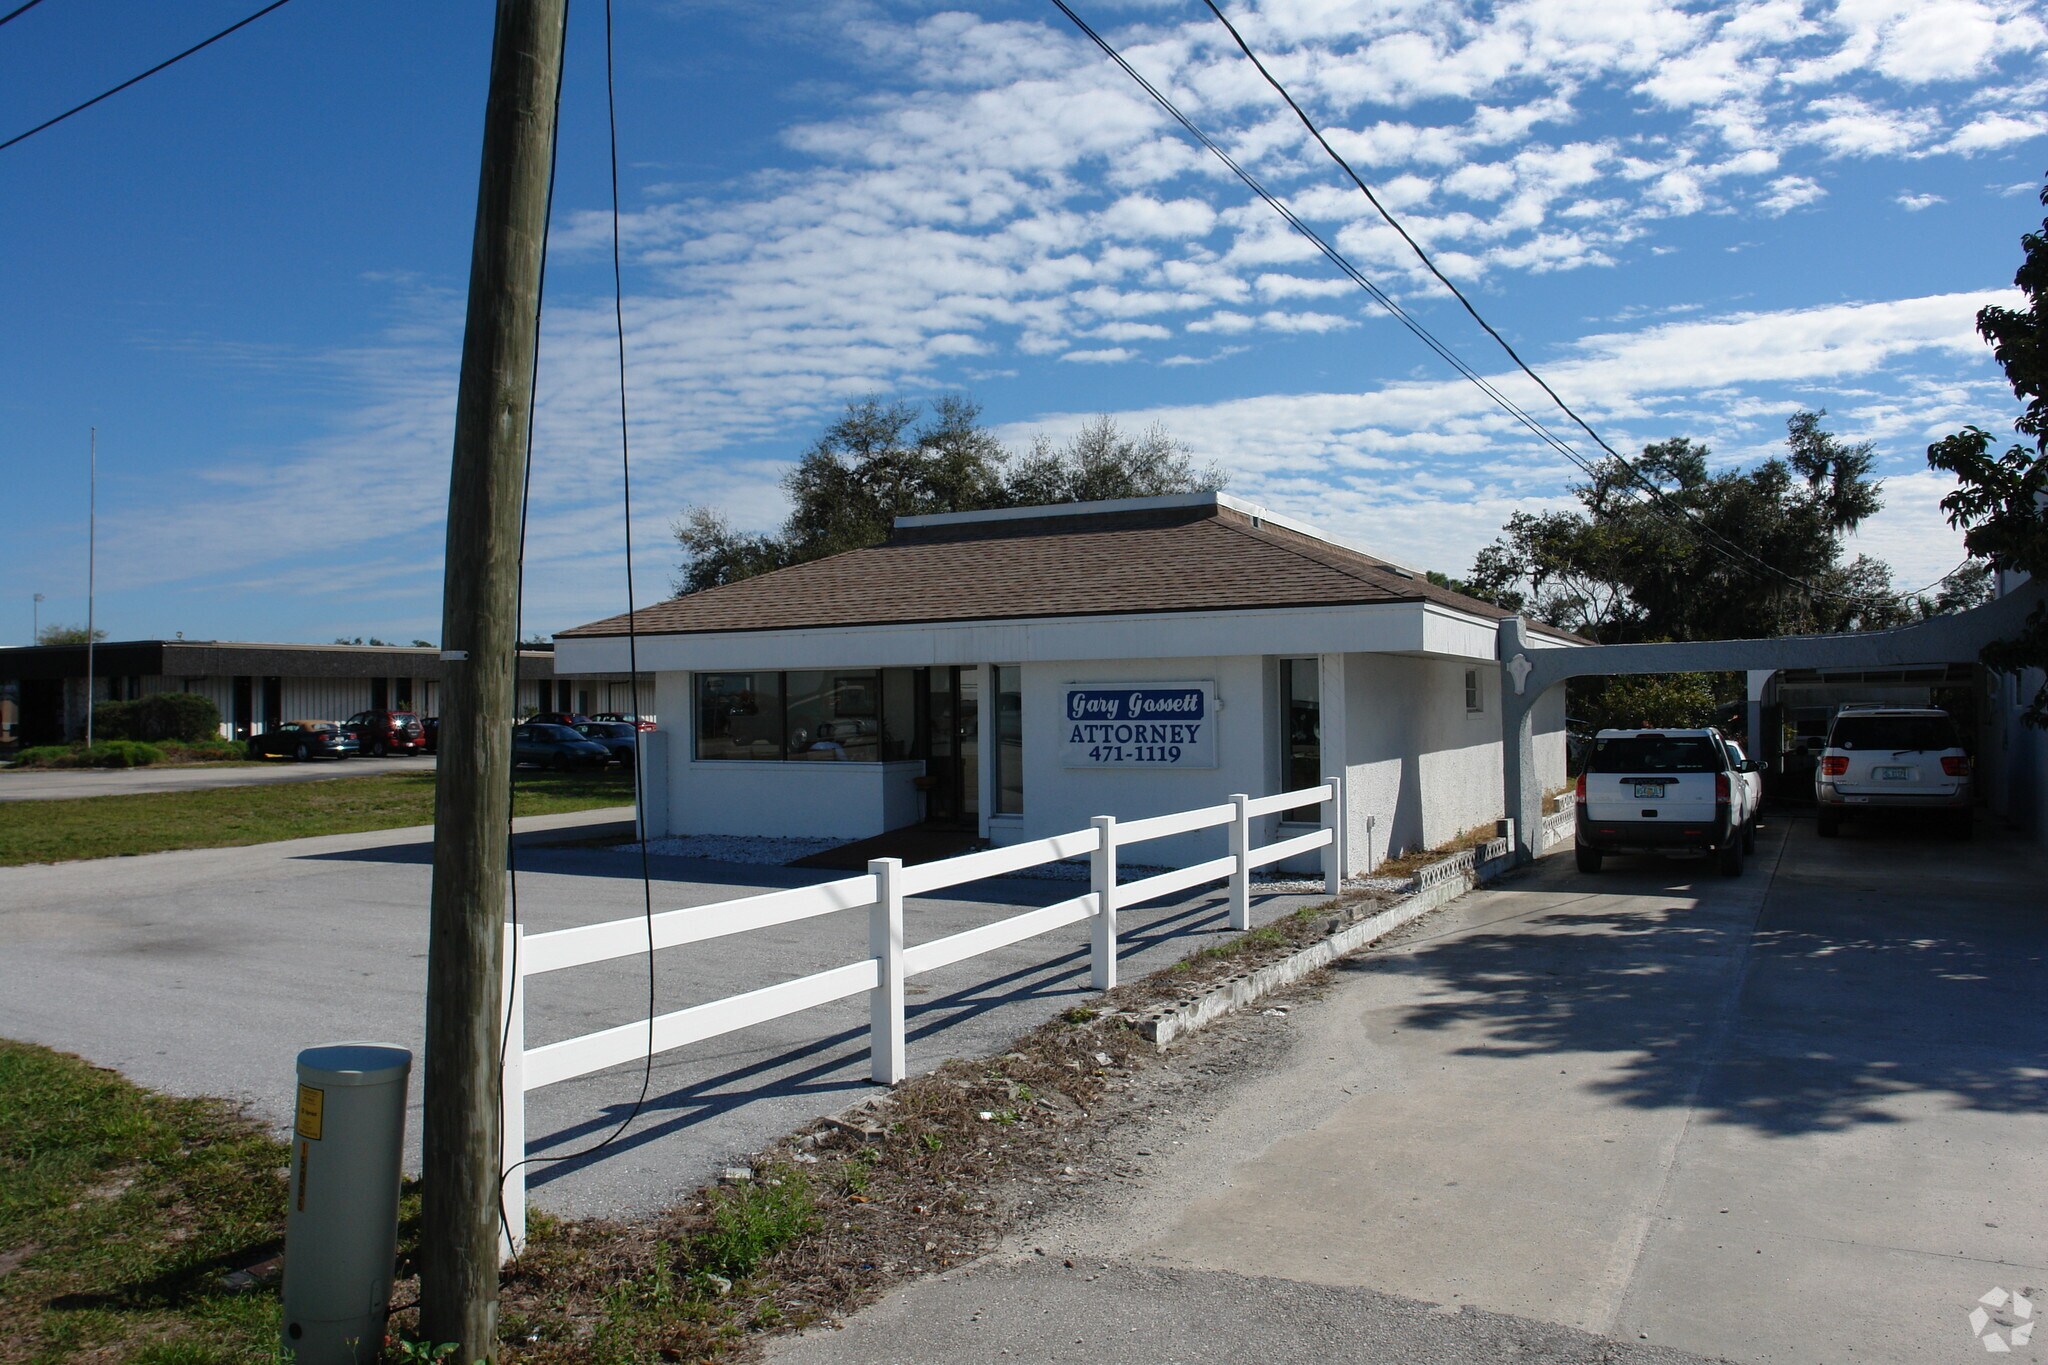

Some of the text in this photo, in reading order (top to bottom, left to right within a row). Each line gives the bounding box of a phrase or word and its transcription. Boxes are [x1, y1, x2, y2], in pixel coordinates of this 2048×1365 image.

[1072, 692, 1198, 720] Gary Gossett
[1069, 724, 1201, 743] ATTORNEY
[1089, 746, 1181, 763] 471-1119
